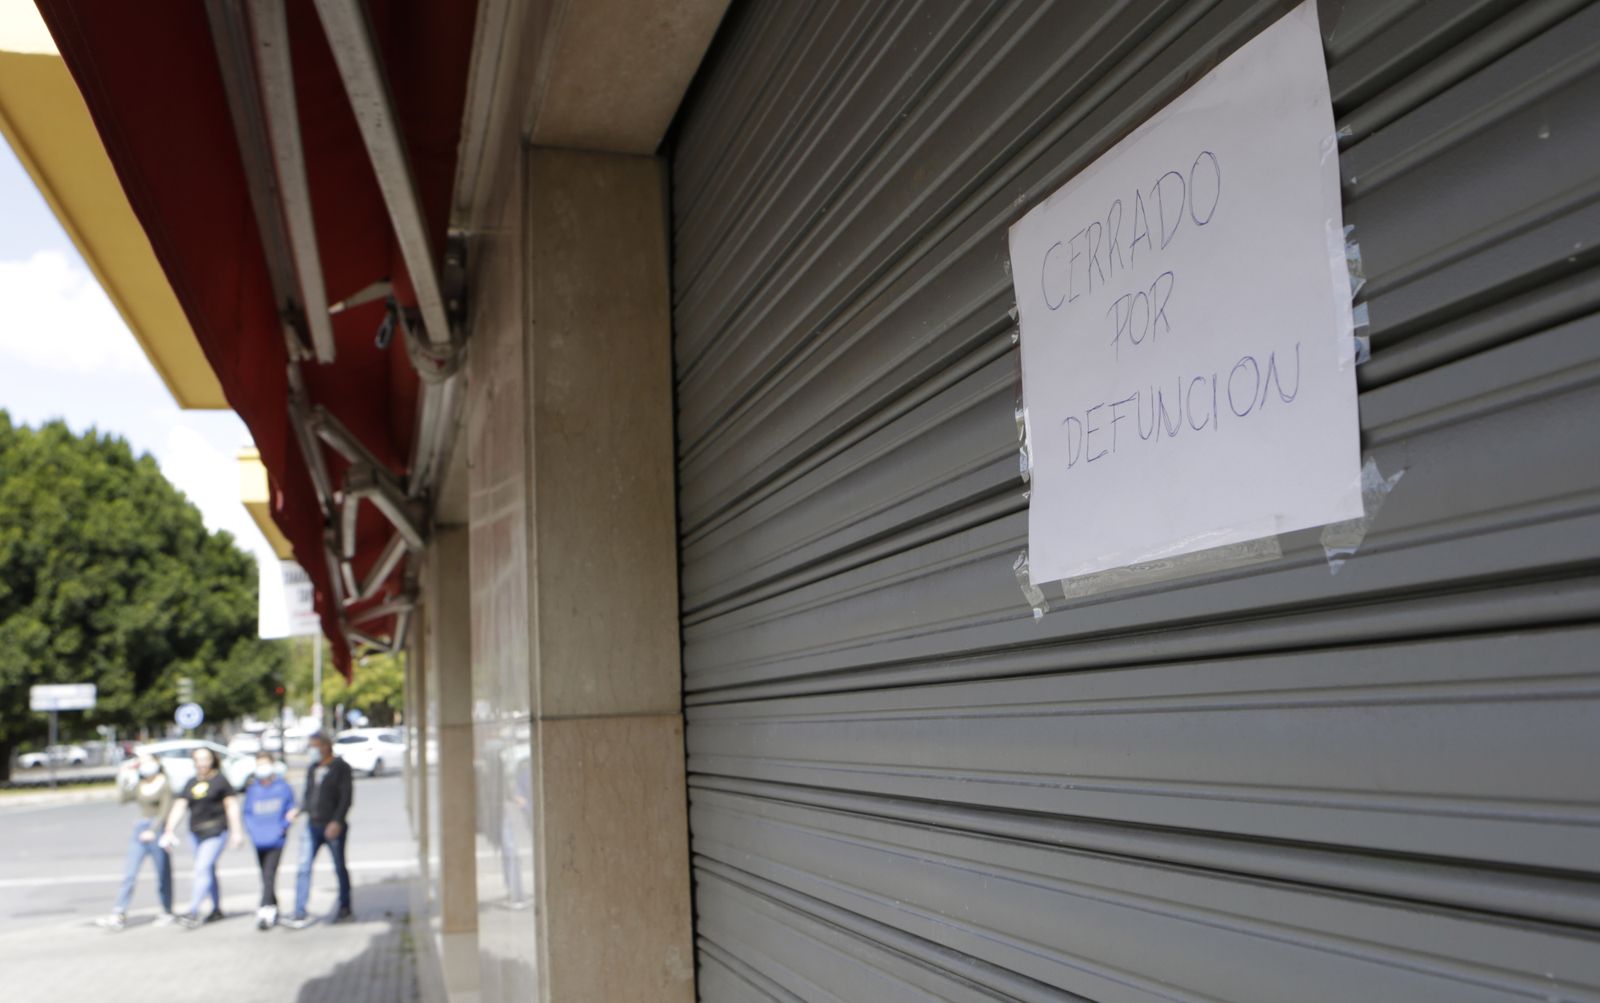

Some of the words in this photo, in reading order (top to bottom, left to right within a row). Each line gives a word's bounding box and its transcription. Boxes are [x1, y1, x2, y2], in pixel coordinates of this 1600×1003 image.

[1041, 150, 1221, 311] CERRADO
[1105, 270, 1175, 361] POR
[1062, 341, 1301, 470] DEFUNCION
